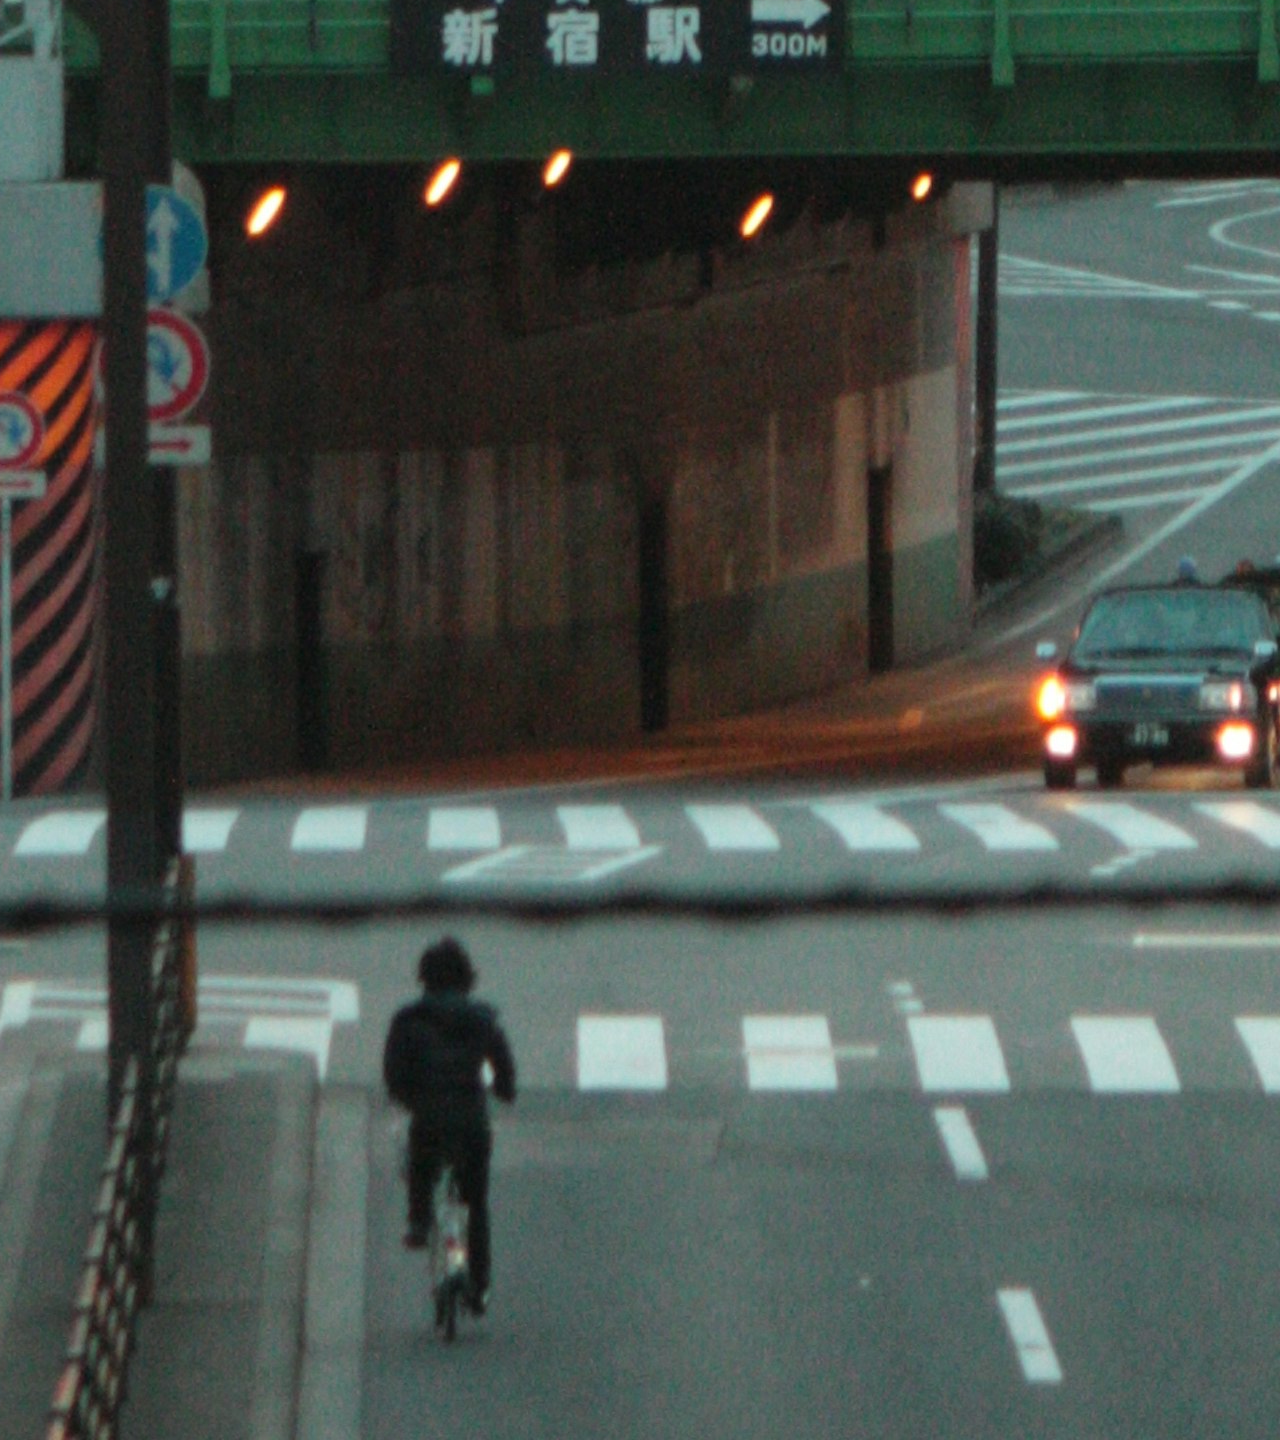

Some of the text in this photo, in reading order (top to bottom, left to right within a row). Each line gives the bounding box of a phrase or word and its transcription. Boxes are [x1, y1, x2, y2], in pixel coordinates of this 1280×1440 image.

[440, 8, 703, 67] 新宿駅
[751, 33, 829, 59] 300M
